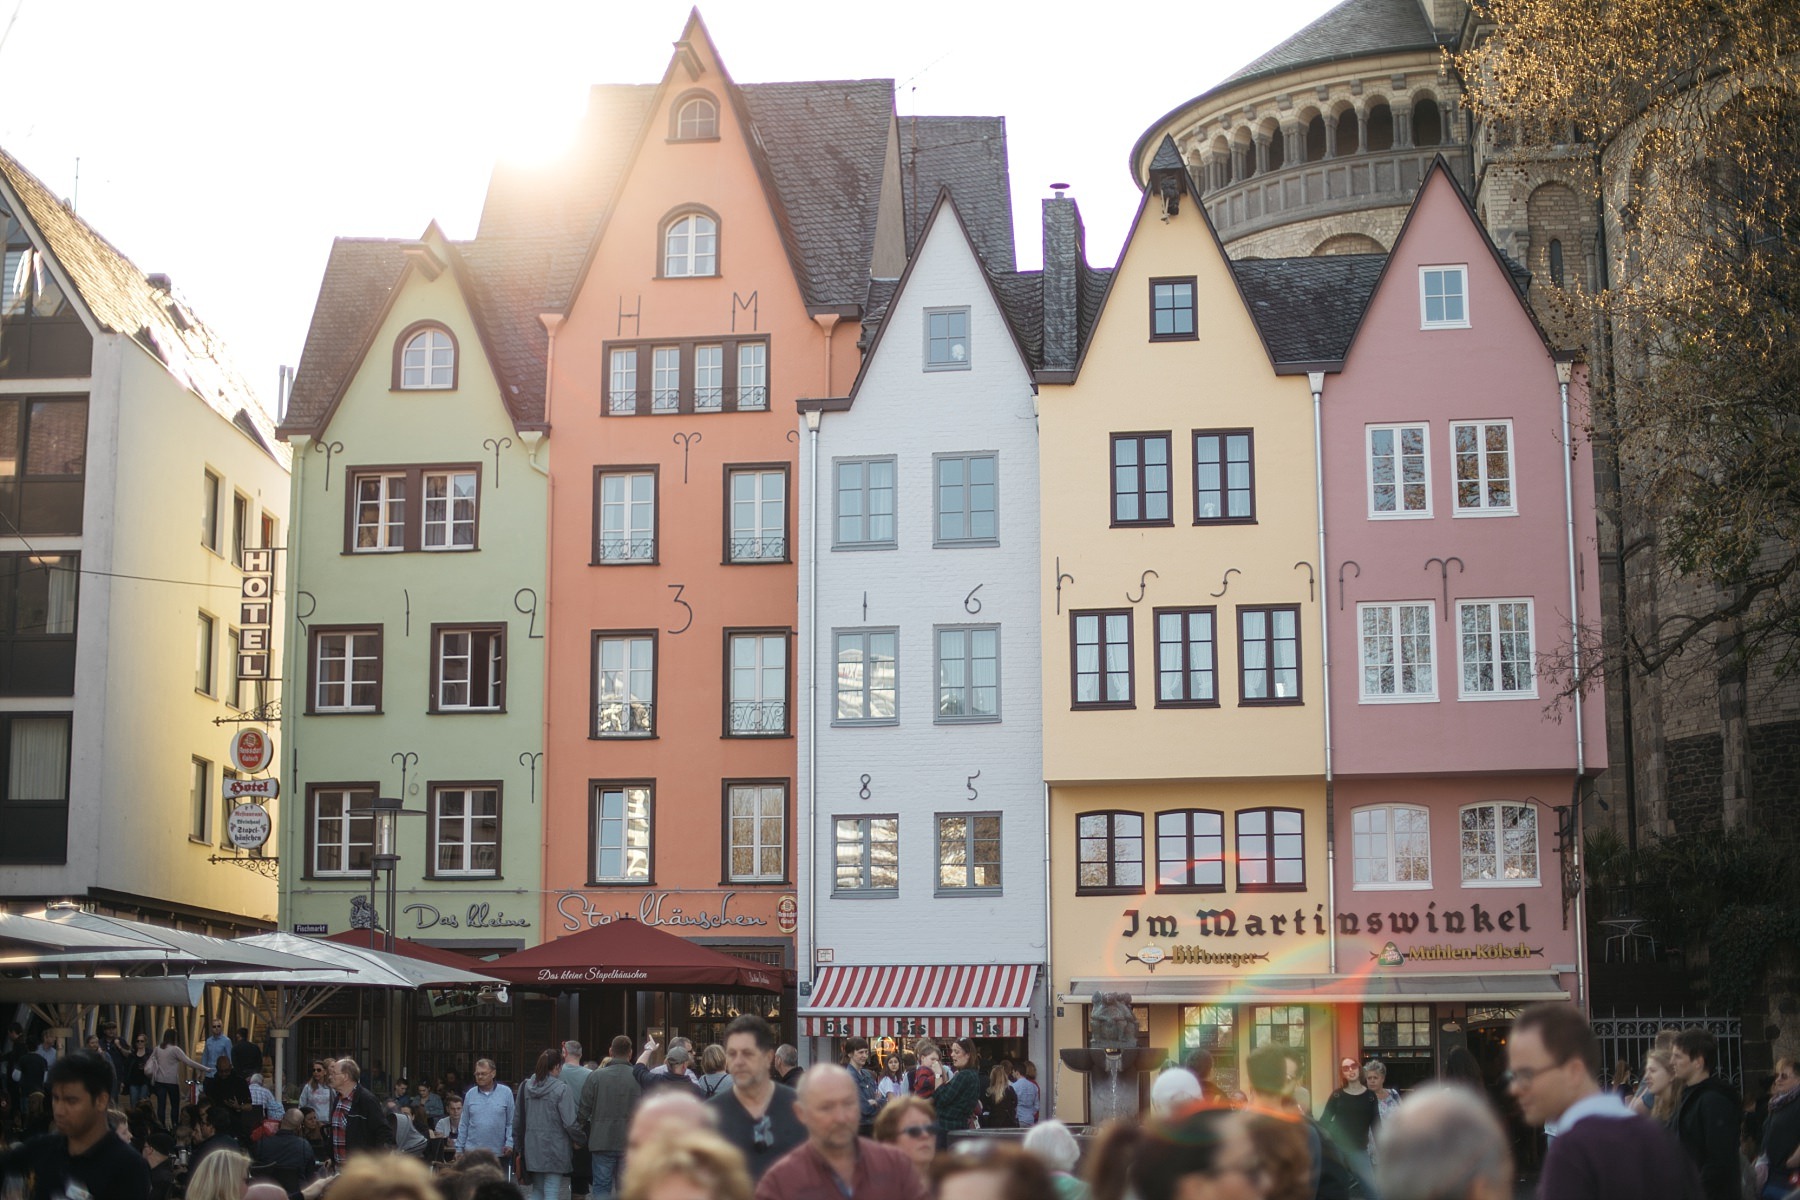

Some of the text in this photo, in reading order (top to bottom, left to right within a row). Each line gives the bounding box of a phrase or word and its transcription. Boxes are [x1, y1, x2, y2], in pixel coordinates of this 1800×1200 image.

[732, 290, 758, 332] M
[243, 552, 267, 675] HOTEL
[667, 585, 693, 634] 3
[964, 583, 983, 614] 6
[230, 781, 269, 794] Hotel
[859, 770, 981, 800] 8 5
[403, 903, 459, 929] Das
[466, 902, 531, 928] kleine
[557, 891, 767, 931] Stalhäuschen
[1122, 901, 1531, 938] Im Martinswinkel
[296, 924, 326, 932] Fischmarkt
[1171, 945, 1257, 968] Bitburger
[1409, 944, 1472, 961] Mühlen
[1476, 942, 1531, 959] Kölsch
[537, 967, 648, 982] Das kleine Stapelhäuschen
[824, 1020, 1000, 1035] Eis Eis Eis
